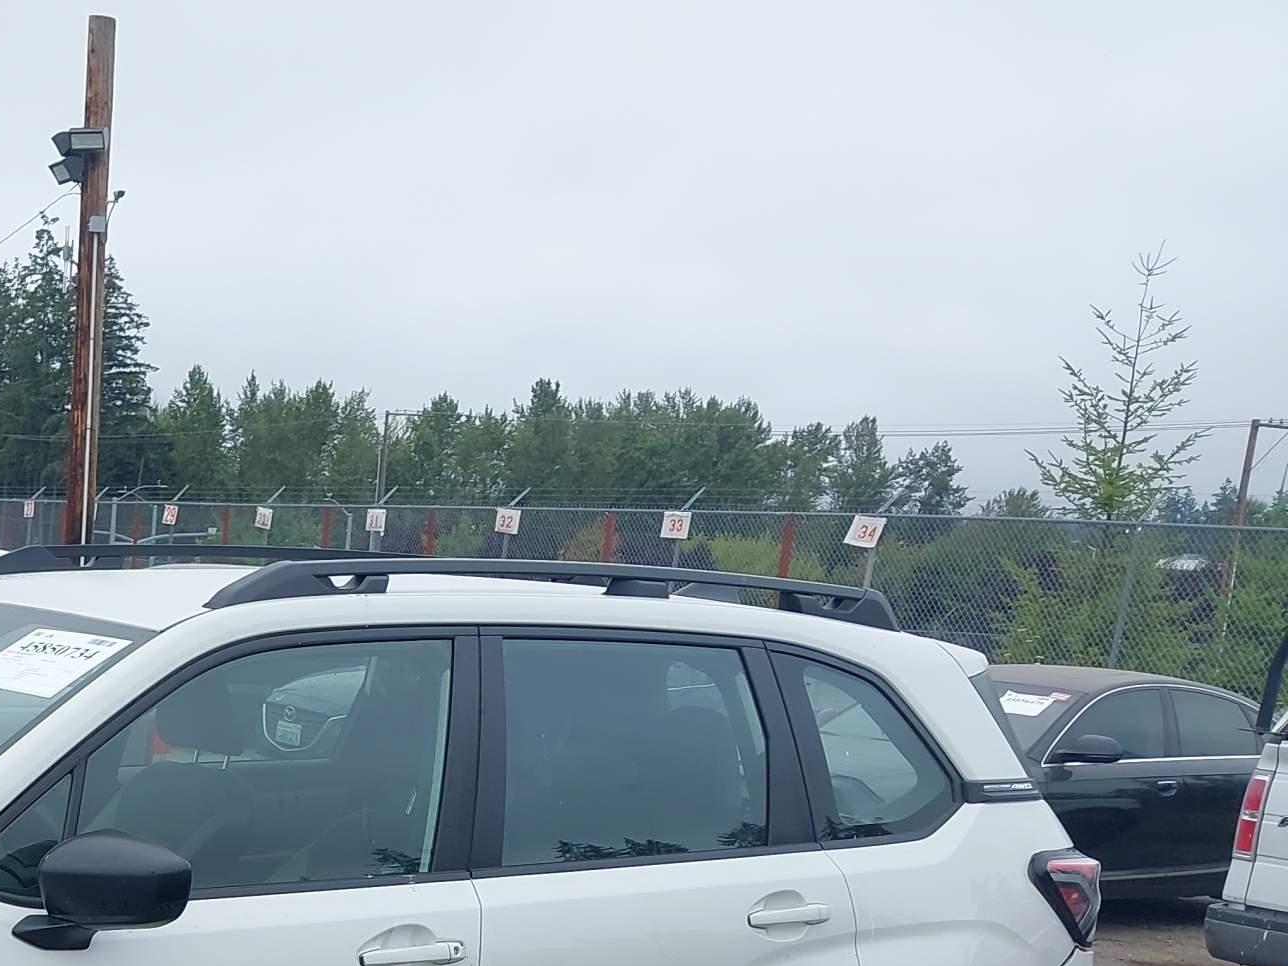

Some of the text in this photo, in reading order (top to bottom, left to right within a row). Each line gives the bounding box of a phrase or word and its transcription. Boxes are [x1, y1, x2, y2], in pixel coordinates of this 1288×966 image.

[164, 506, 176, 523] 29
[368, 515, 379, 527] 31
[500, 515, 513, 528] 32
[669, 518, 684, 532] 33
[857, 525, 878, 541] 34
[20, 641, 101, 661] 45850734
